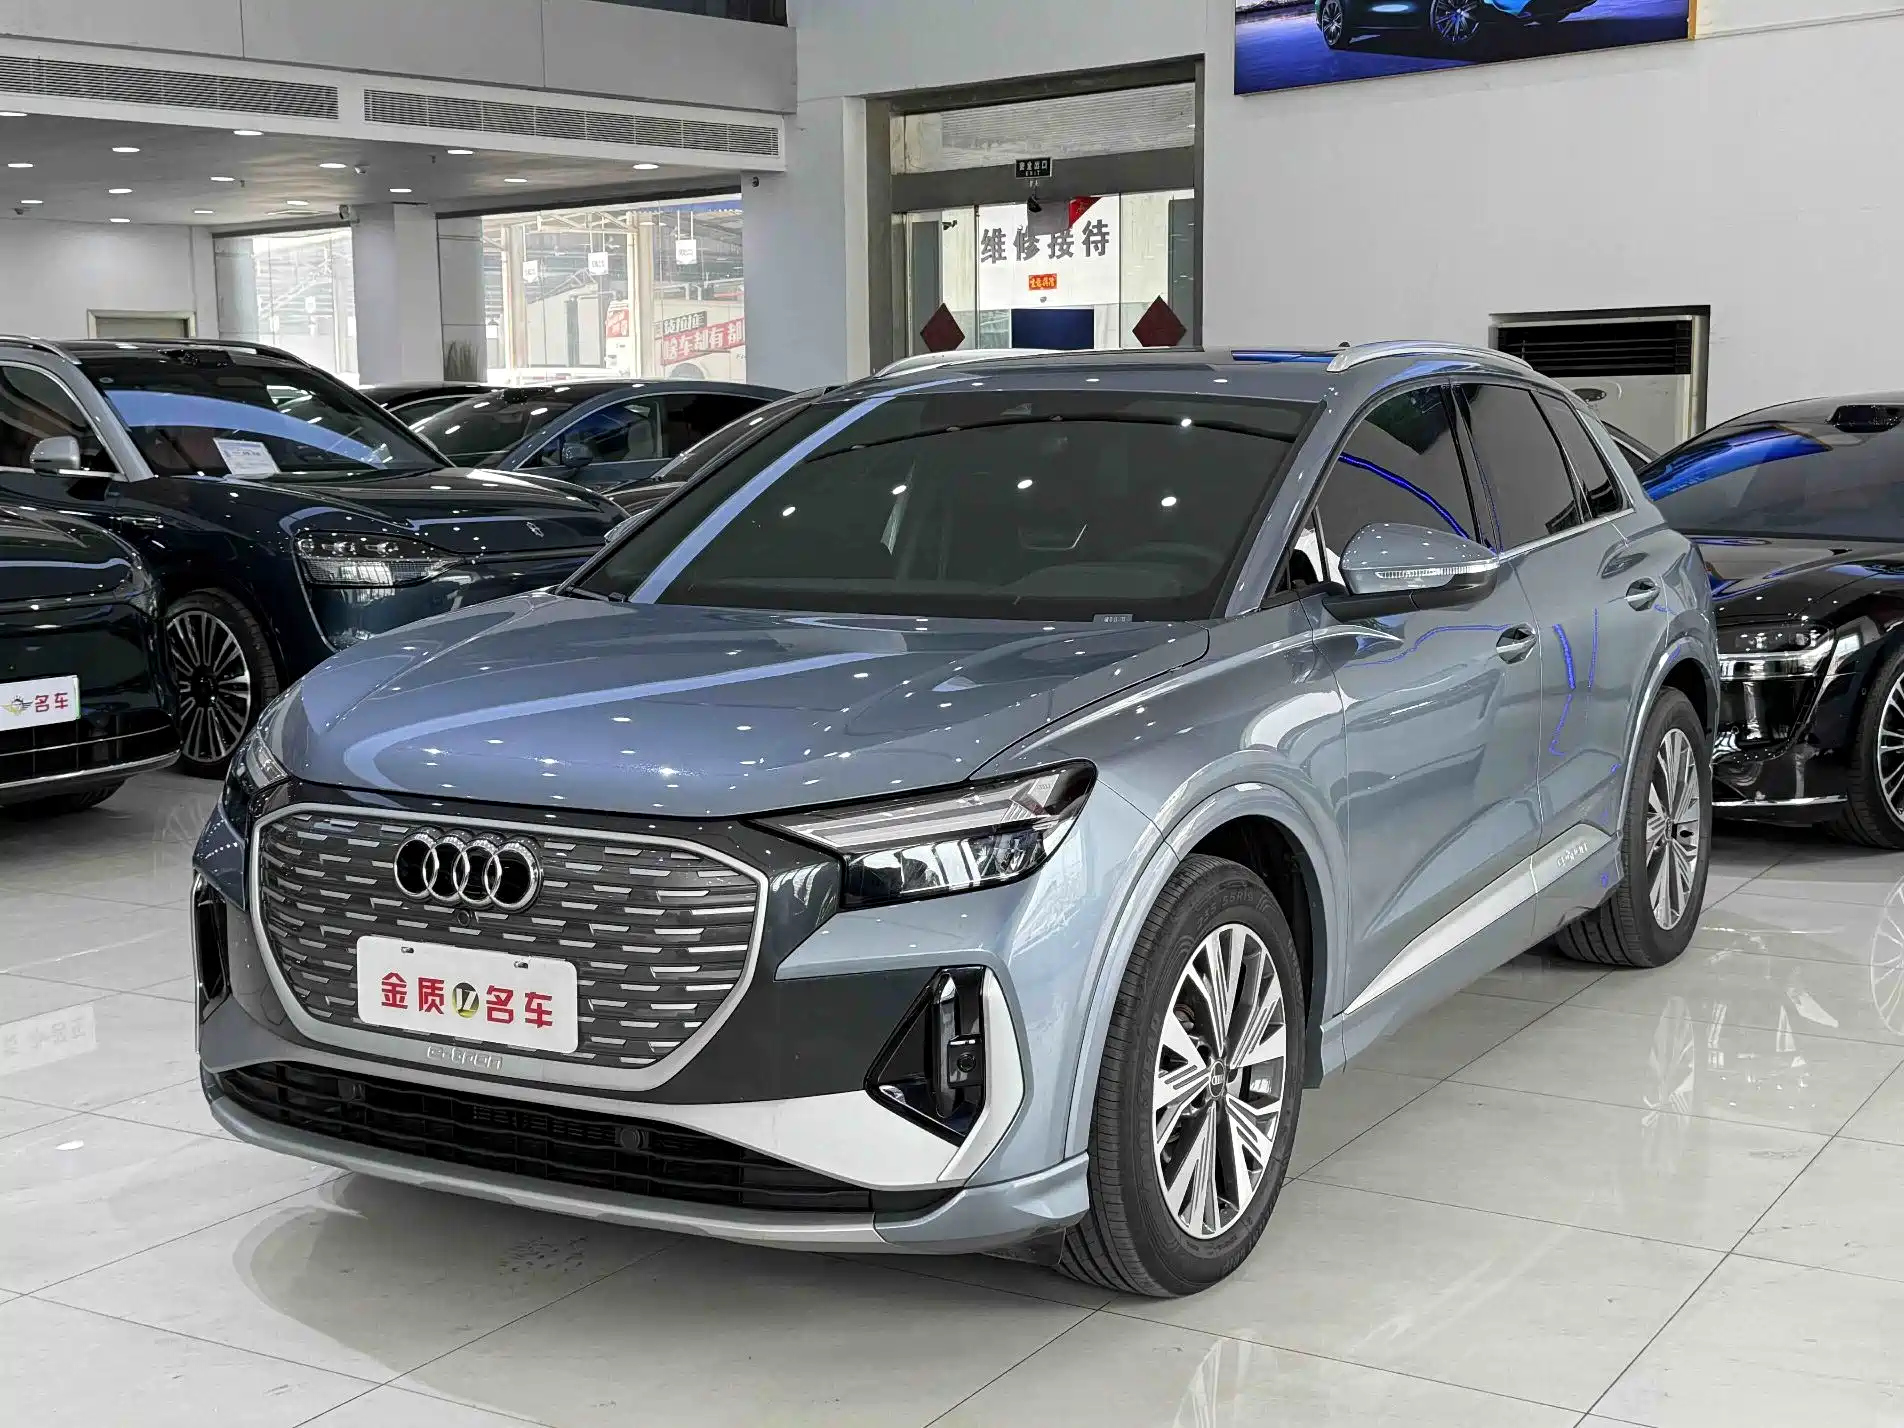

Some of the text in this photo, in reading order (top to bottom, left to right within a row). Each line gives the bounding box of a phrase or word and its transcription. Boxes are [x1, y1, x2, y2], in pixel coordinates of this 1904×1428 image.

[980, 218, 1110, 264] 维修接待
[35, 692, 69, 712] 名车
[381, 971, 445, 1015] 金质
[486, 985, 553, 1029] 名车
